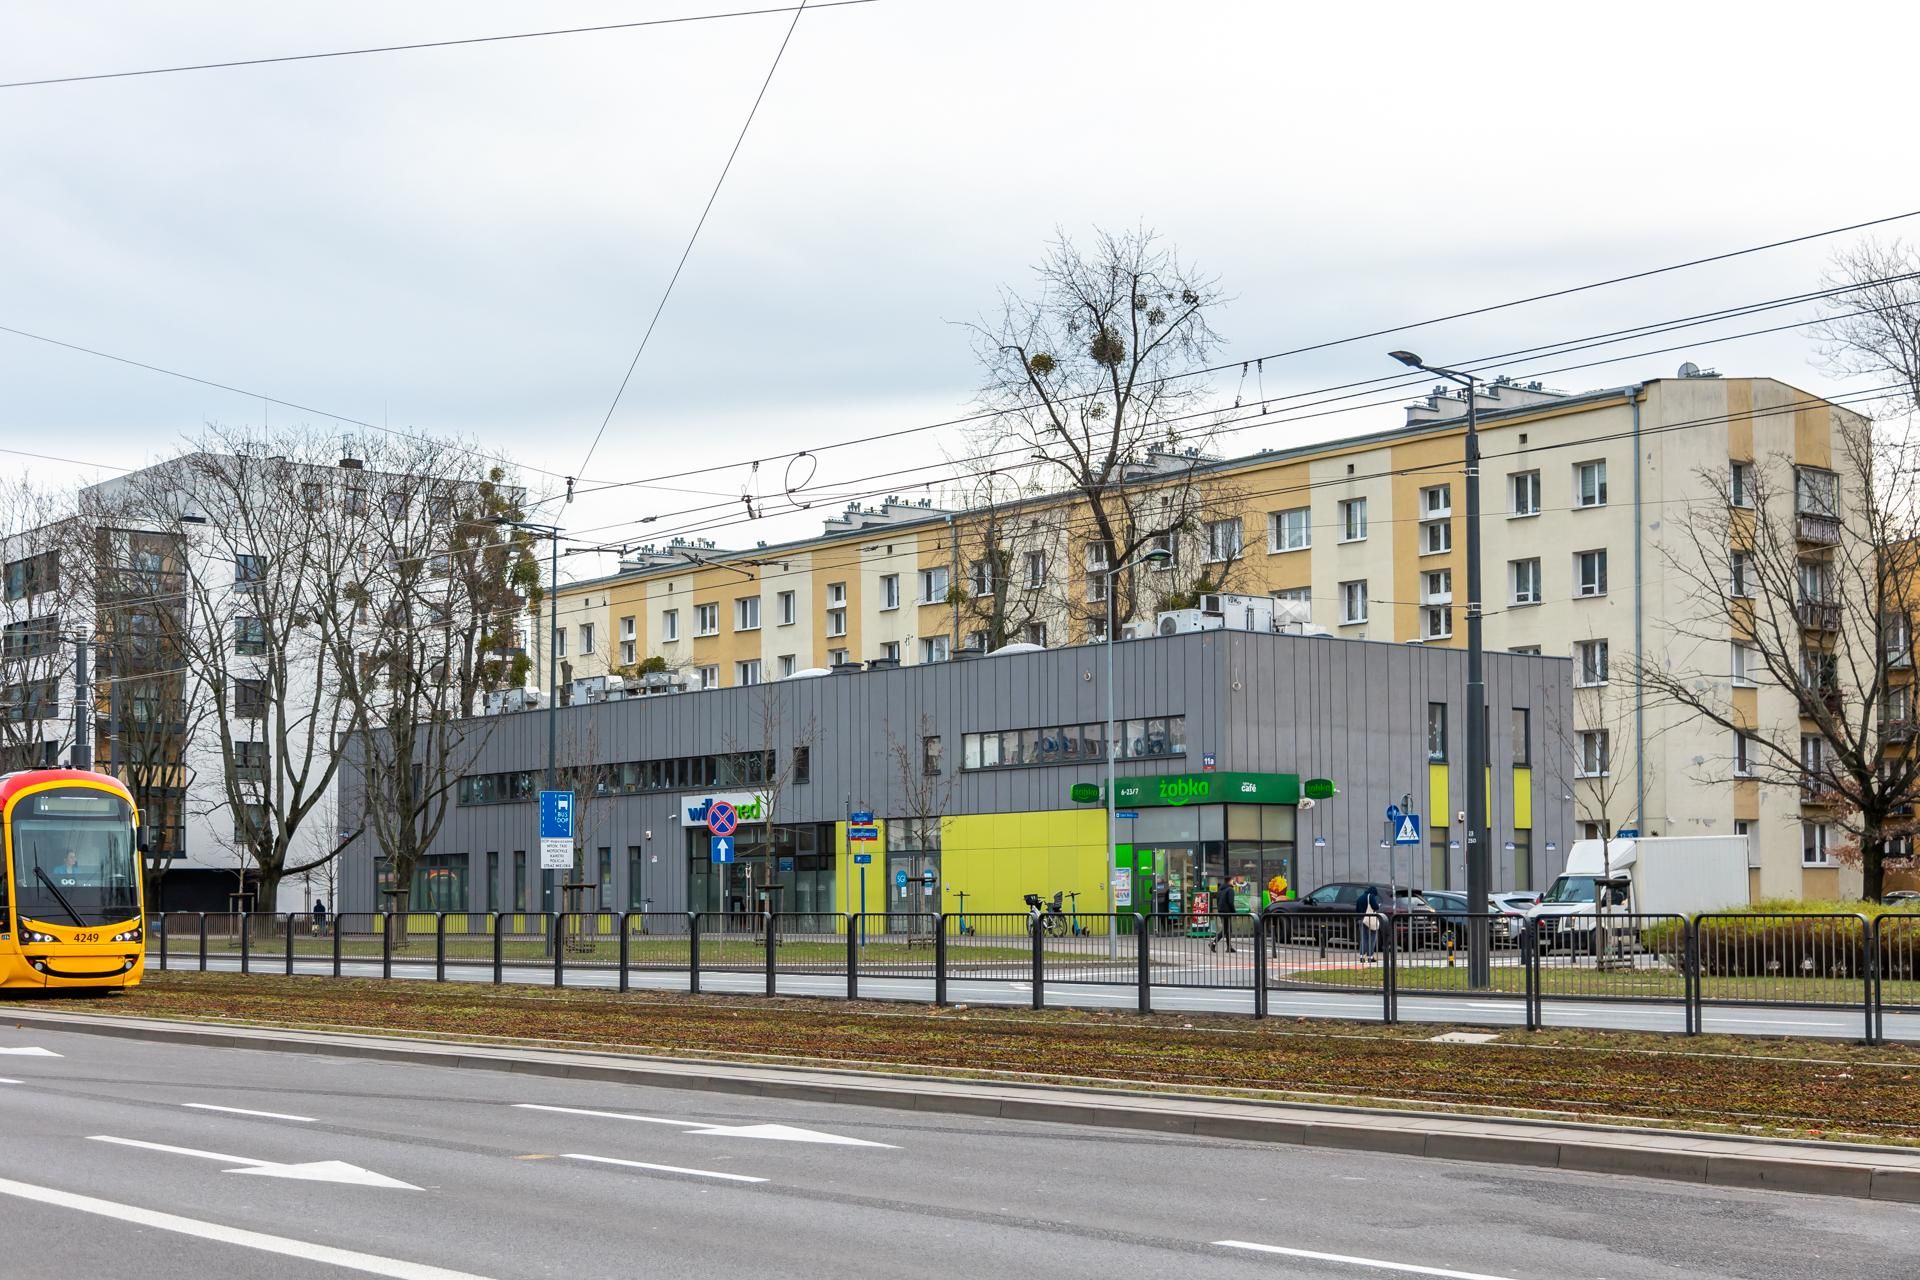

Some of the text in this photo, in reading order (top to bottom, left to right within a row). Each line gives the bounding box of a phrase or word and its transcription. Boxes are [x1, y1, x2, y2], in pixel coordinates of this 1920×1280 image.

[1204, 757, 1214, 765] 11a
[1160, 778, 1209, 798] żabka
[1241, 783, 1257, 793] café
[73, 933, 99, 942] 4249
